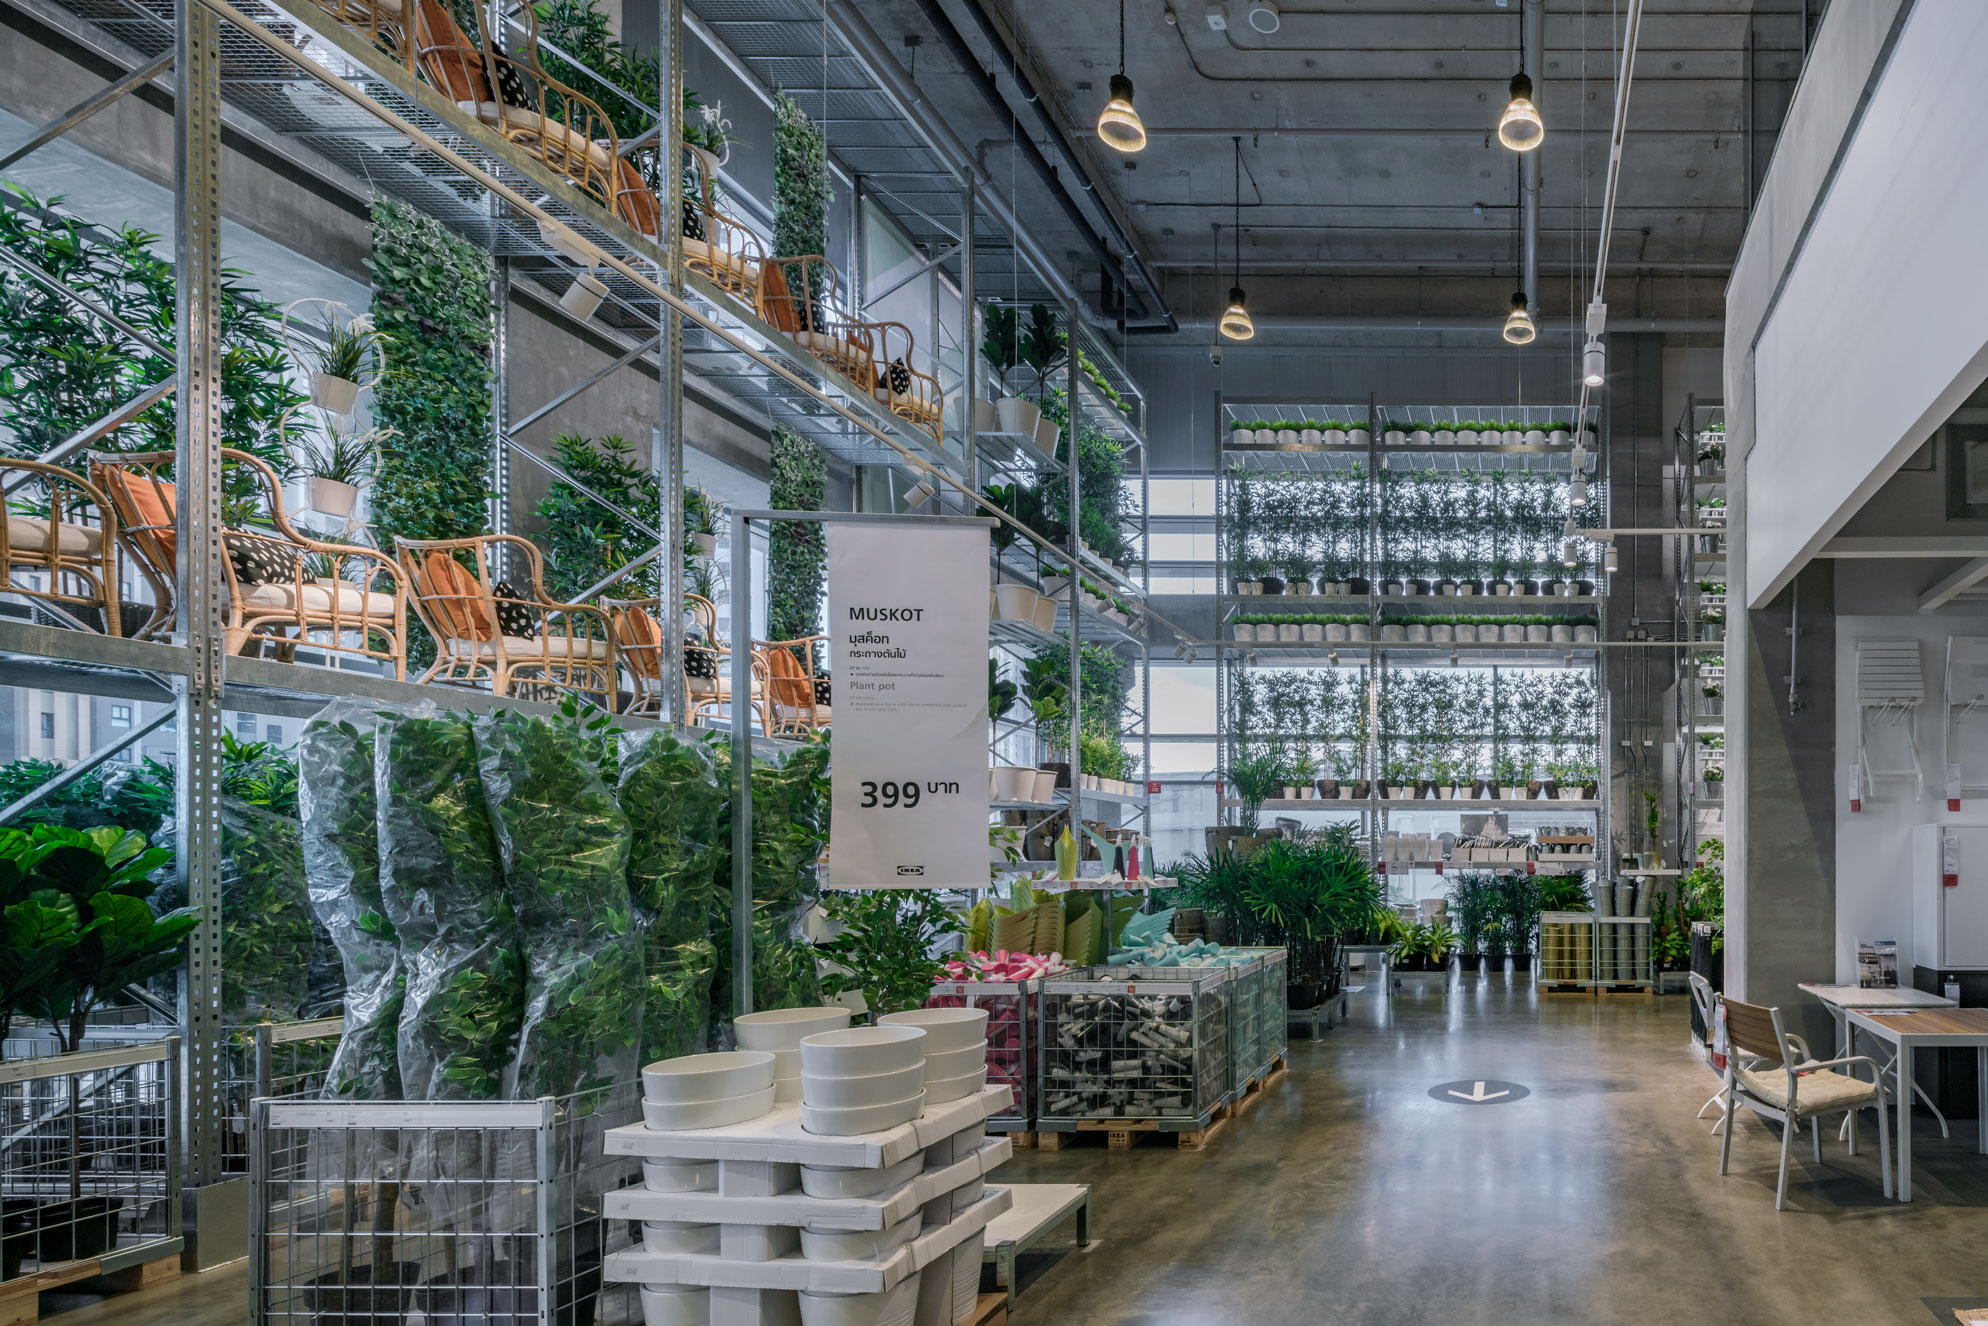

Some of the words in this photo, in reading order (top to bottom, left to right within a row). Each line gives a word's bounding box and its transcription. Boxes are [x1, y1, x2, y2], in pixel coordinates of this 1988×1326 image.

[849, 607, 924, 622] MUSKOT
[849, 630, 890, 648] มุสค็อท
[849, 647, 907, 659] กระถางต้นไม้
[849, 681, 875, 690] Plant
[878, 682, 896, 692] pot
[860, 781, 921, 808] 399
[927, 781, 960, 794] บาท
